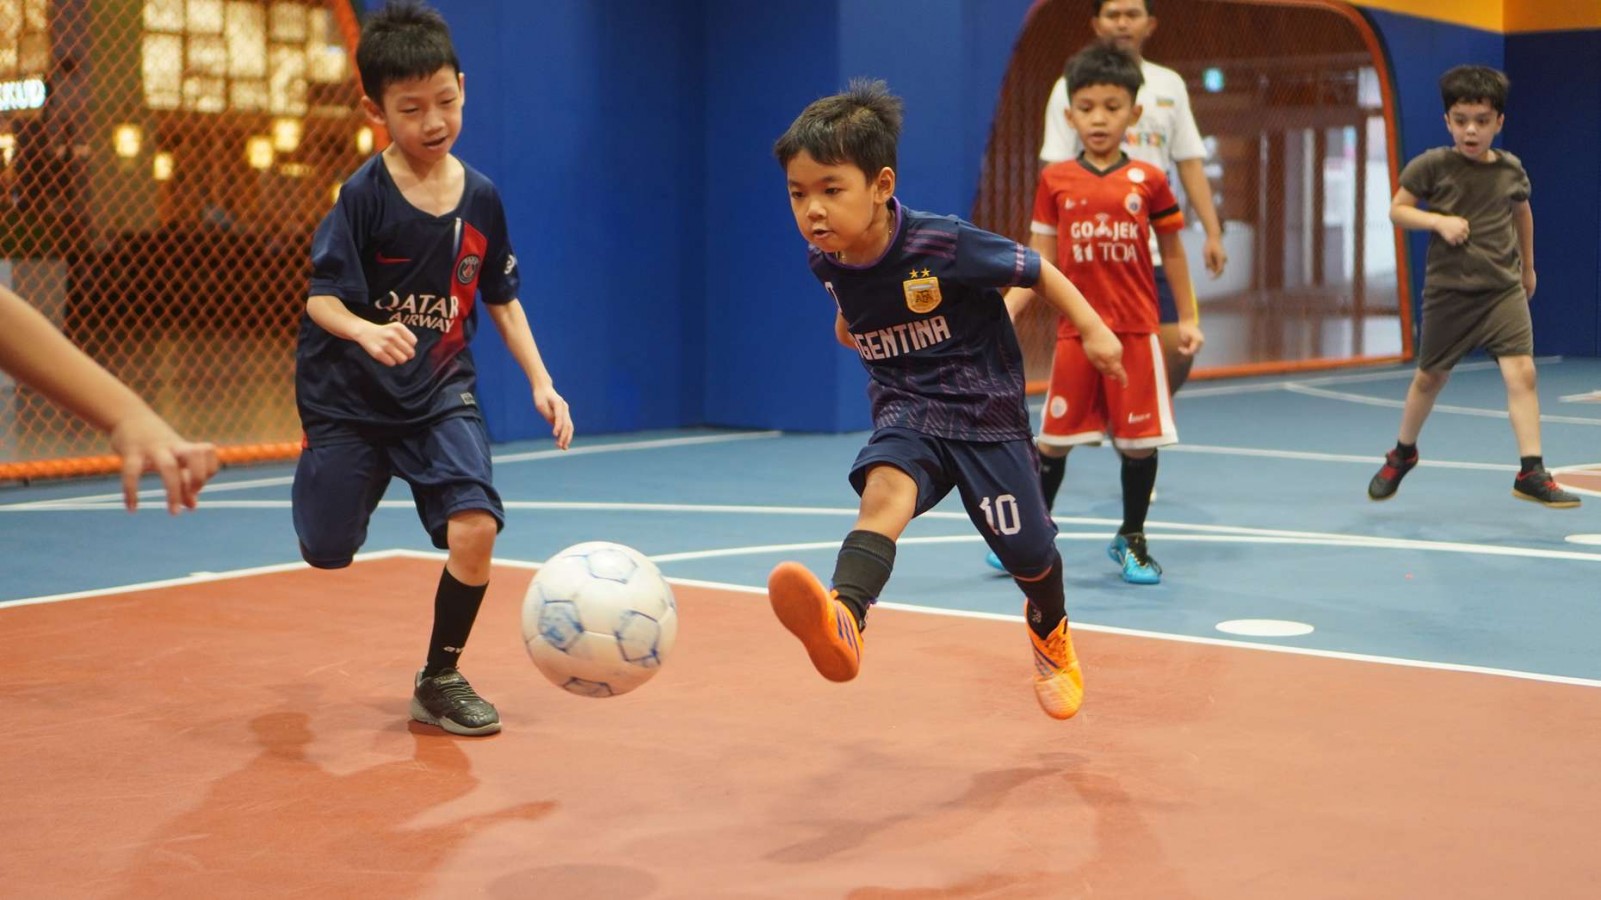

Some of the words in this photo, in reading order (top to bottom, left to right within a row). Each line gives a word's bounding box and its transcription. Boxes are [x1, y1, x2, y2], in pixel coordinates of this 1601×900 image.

[1097, 242, 1138, 263] TOA
[374, 290, 459, 320] QATAR
[852, 315, 952, 360] GENTINA
[979, 494, 1021, 536] 10
